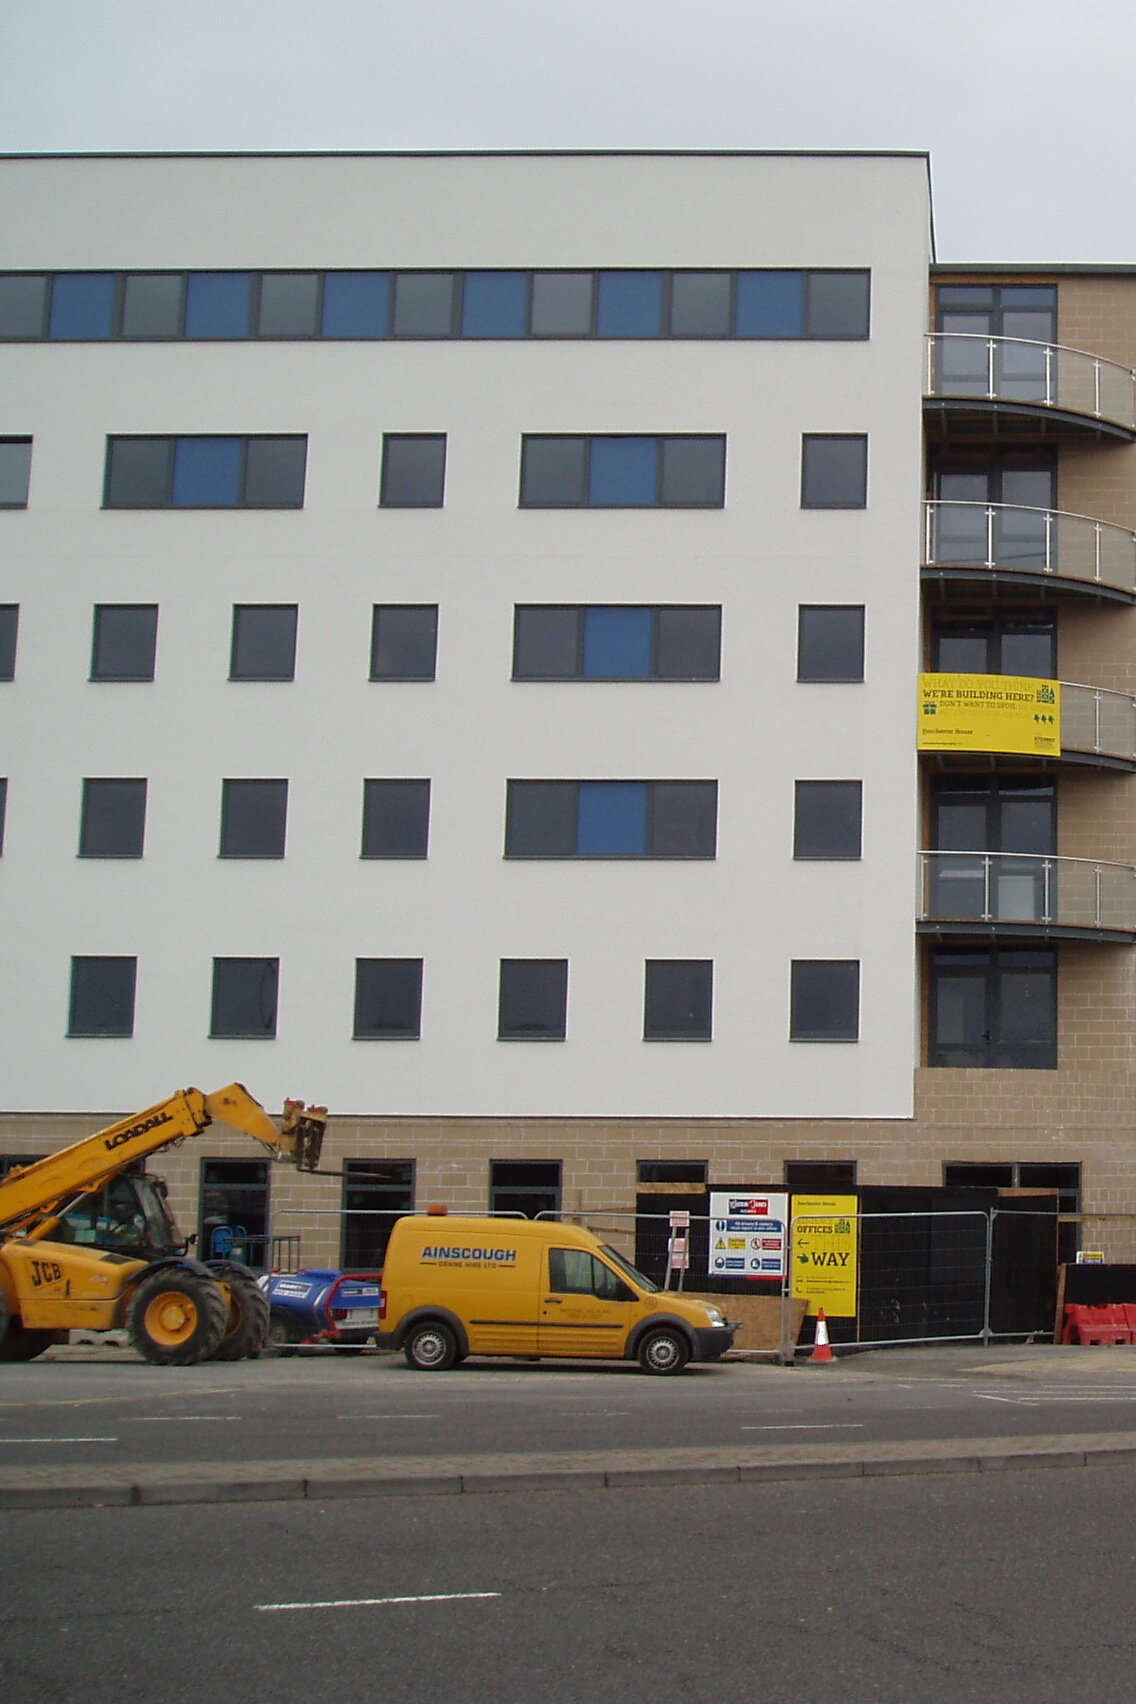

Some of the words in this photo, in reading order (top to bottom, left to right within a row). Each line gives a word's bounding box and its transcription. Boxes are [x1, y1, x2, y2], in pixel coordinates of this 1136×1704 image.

[923, 689, 954, 699] WE'RE
[956, 690, 1003, 700] BUILDING
[1005, 692, 1035, 703] HERE?
[939, 700, 962, 708] DON'T
[963, 701, 985, 709] WANT
[986, 701, 997, 710] TO
[104, 1112, 173, 1150] LOADALL
[796, 1225, 833, 1234] OFFICES
[420, 1246, 517, 1262] AINSCOUGH
[811, 1251, 850, 1267] WAY
[31, 1260, 62, 1287] JCB
